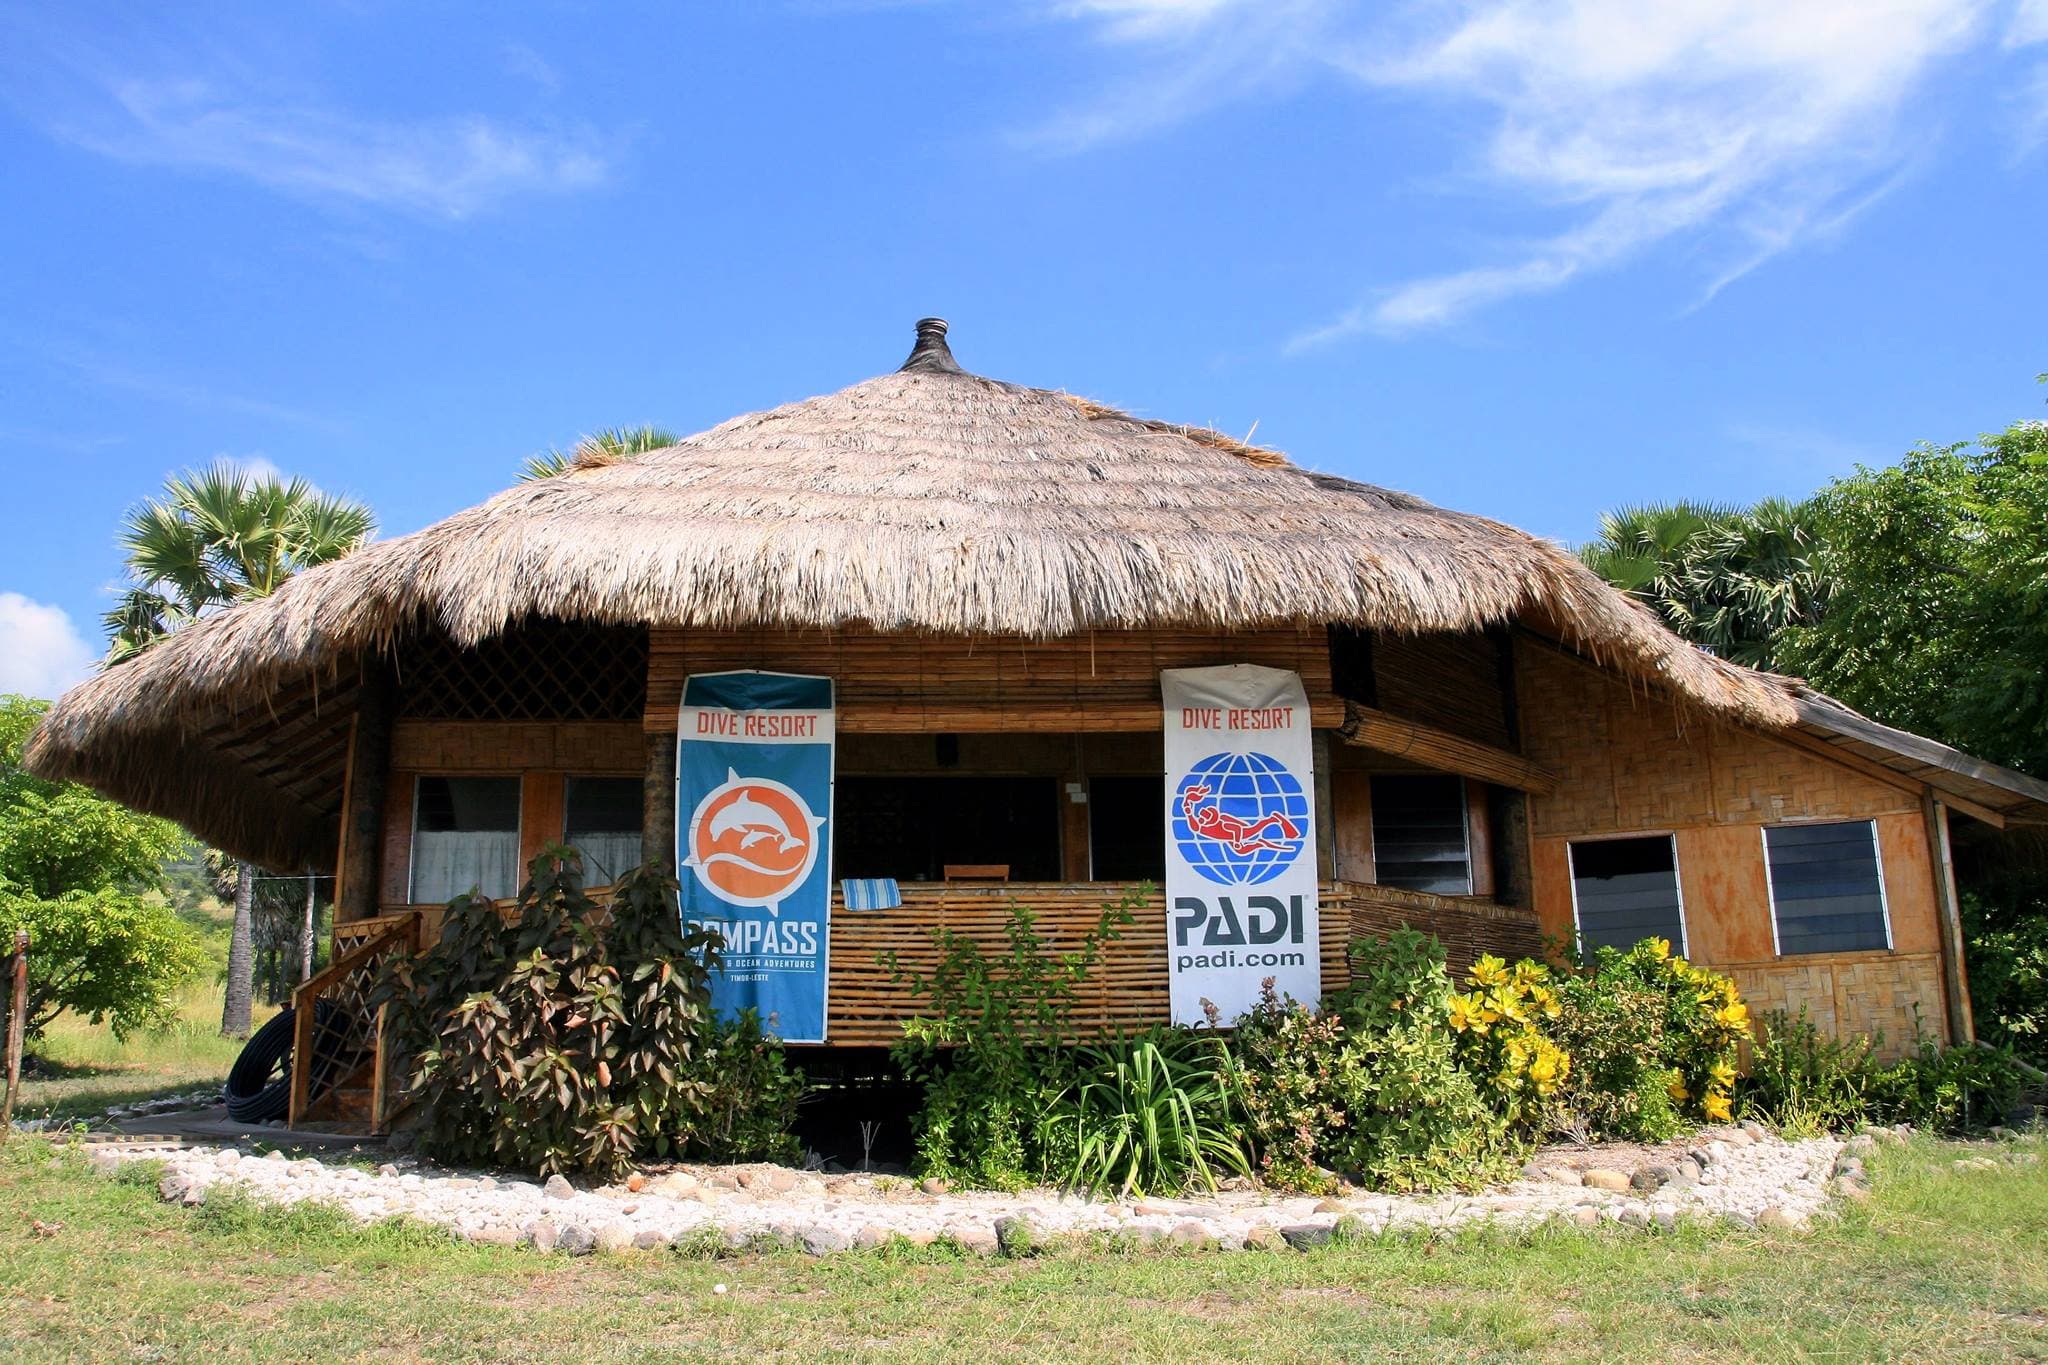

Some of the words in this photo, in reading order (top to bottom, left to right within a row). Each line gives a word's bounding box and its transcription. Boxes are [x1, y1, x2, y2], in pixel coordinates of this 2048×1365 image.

[697, 712, 738, 735] DIVE
[745, 715, 817, 737] RESORT
[1182, 708, 1222, 729] DIVE
[1228, 708, 1293, 730] RESORT
[1174, 895, 1304, 946] PADI
[735, 959, 761, 968] OCEAN
[764, 959, 815, 969] ADVENTURES
[1177, 951, 1305, 973] padi.com
